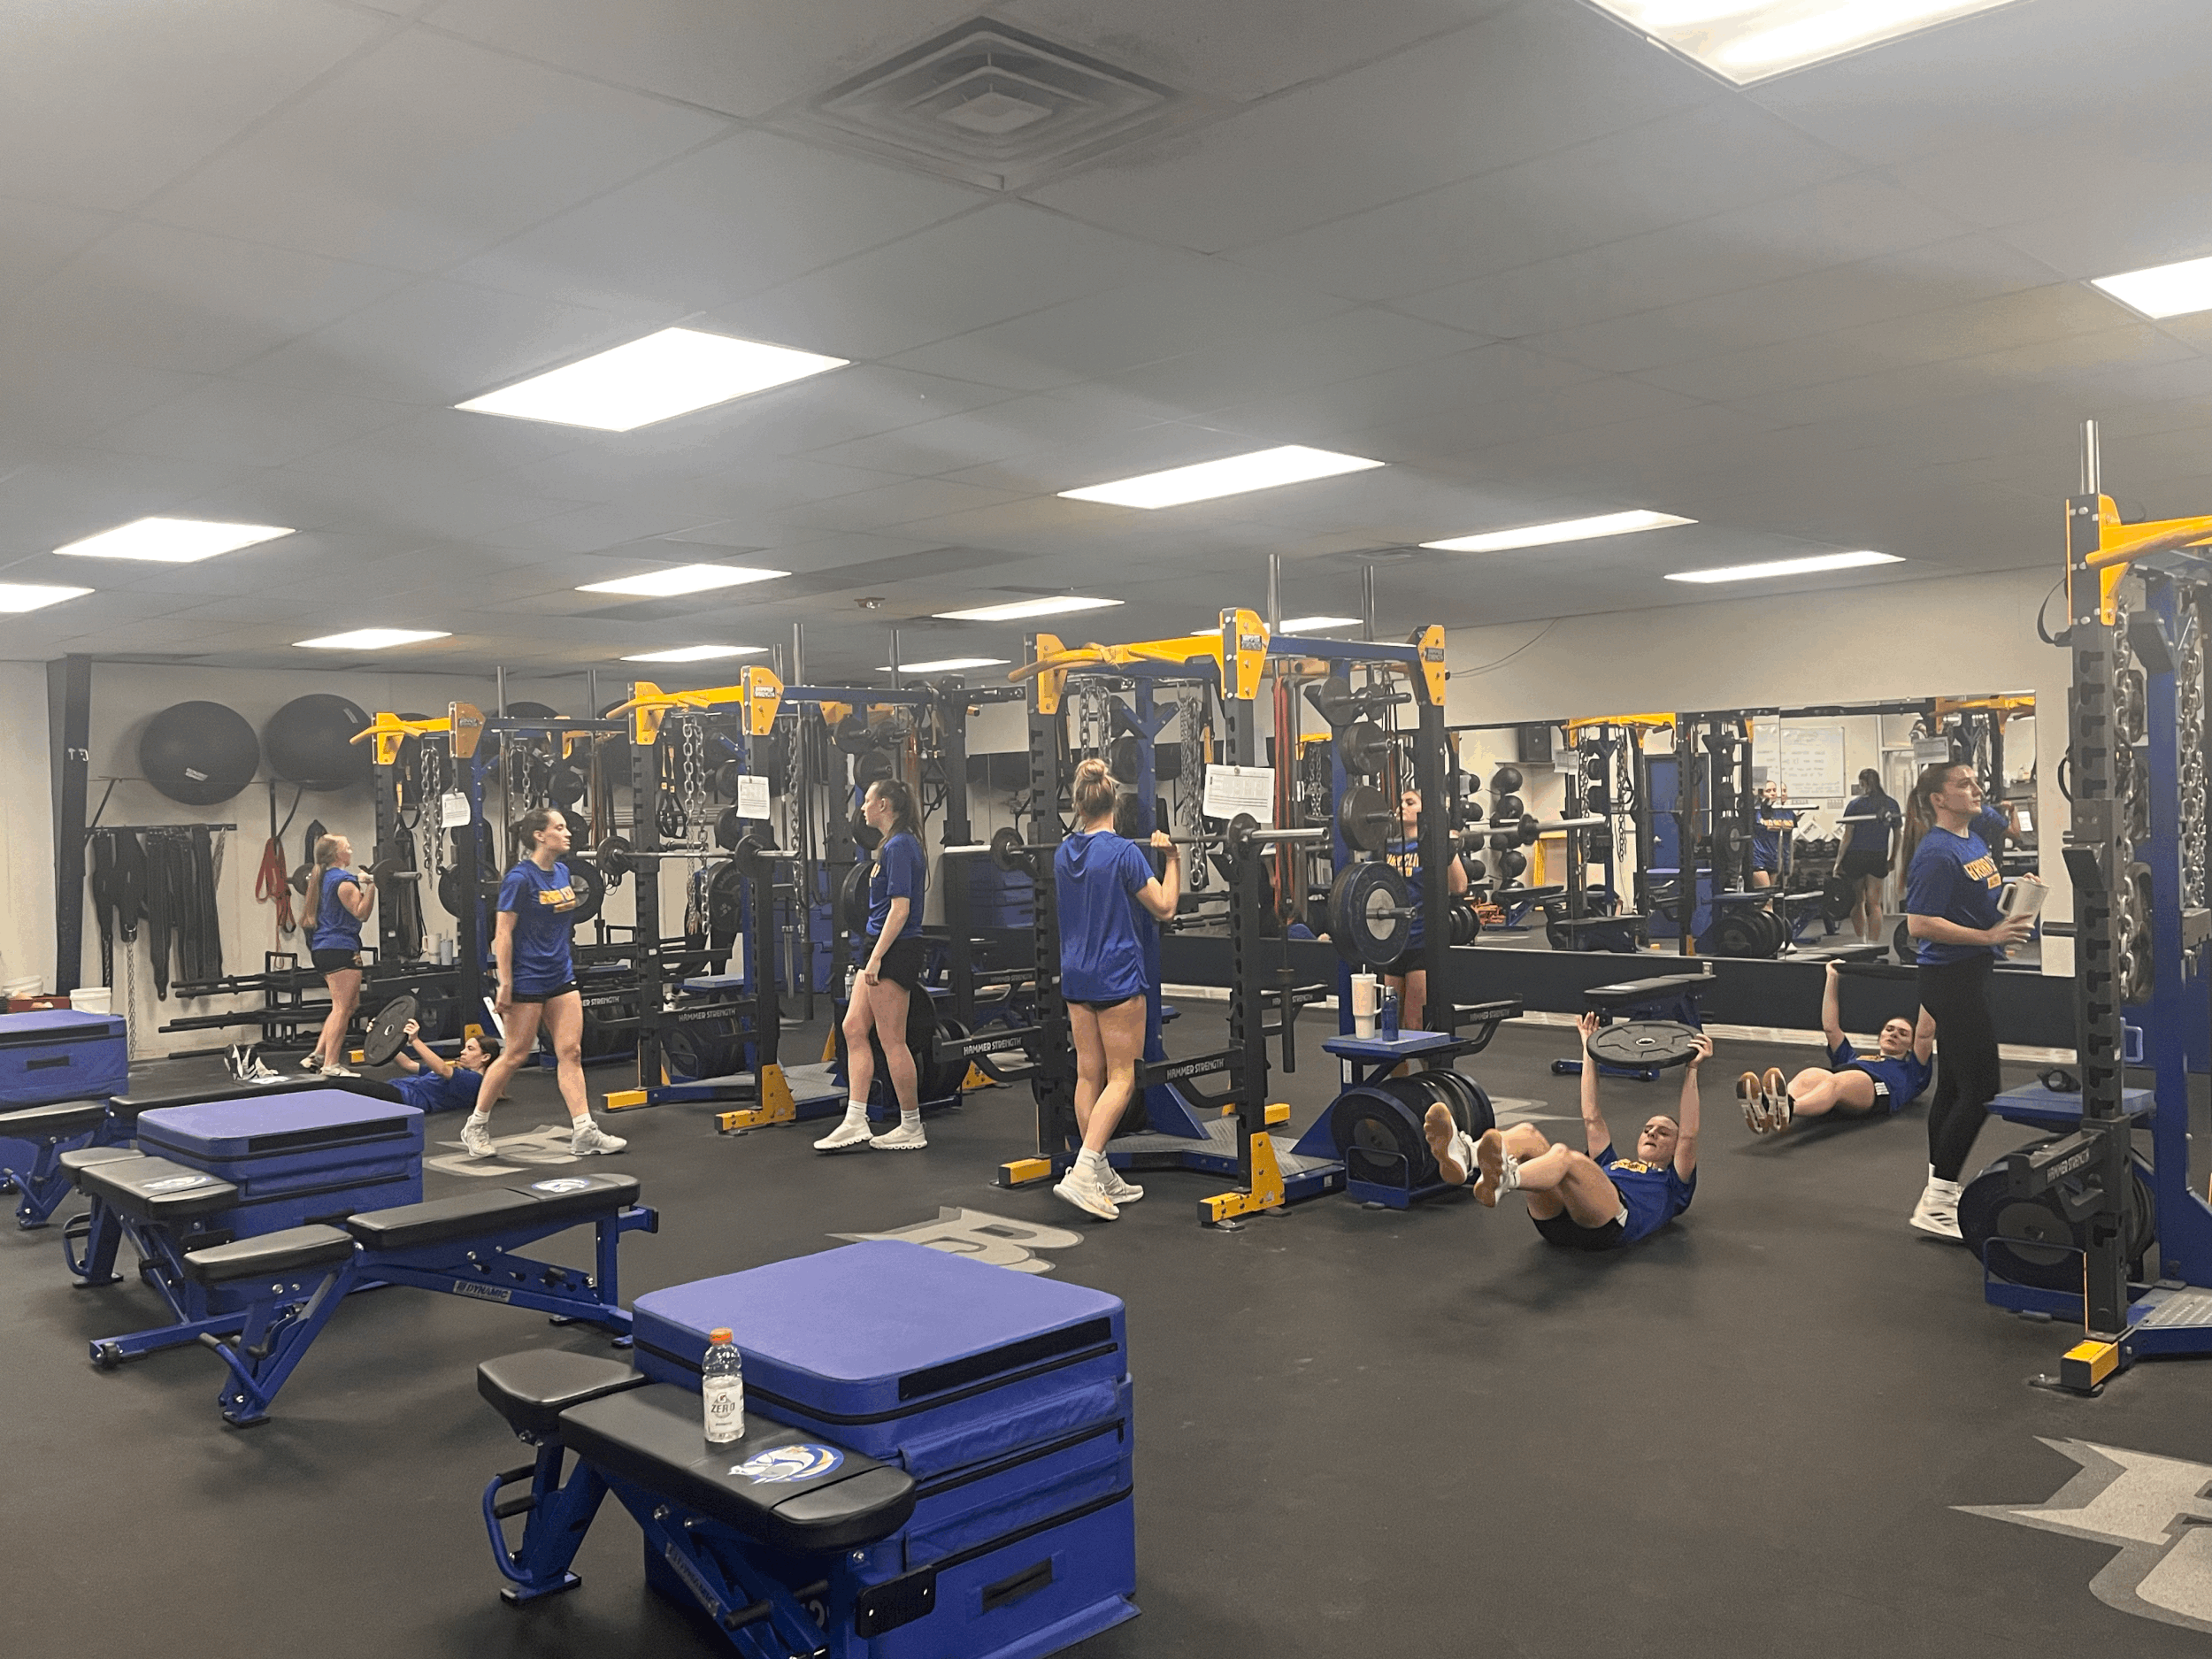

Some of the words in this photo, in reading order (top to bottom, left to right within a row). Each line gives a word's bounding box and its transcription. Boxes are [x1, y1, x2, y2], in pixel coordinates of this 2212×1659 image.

[591, 996, 620, 1006] STRENGTH
[1292, 994, 1313, 1003] STRENGTH
[679, 1010, 706, 1022] HAMMER
[707, 1007, 736, 1019] STRENGTH
[963, 1042, 991, 1056] HAMMER
[991, 1037, 1022, 1050] STRENGTH
[1166, 1064, 1194, 1079] HAMMER
[1194, 1058, 1225, 1074] STRENGTH
[2047, 1160, 2068, 1184] HAMMER
[2068, 1148, 2089, 1171] STRENGTH
[465, 1283, 509, 1299] DYNAMIC
[710, 1402, 735, 1414] ZERO
